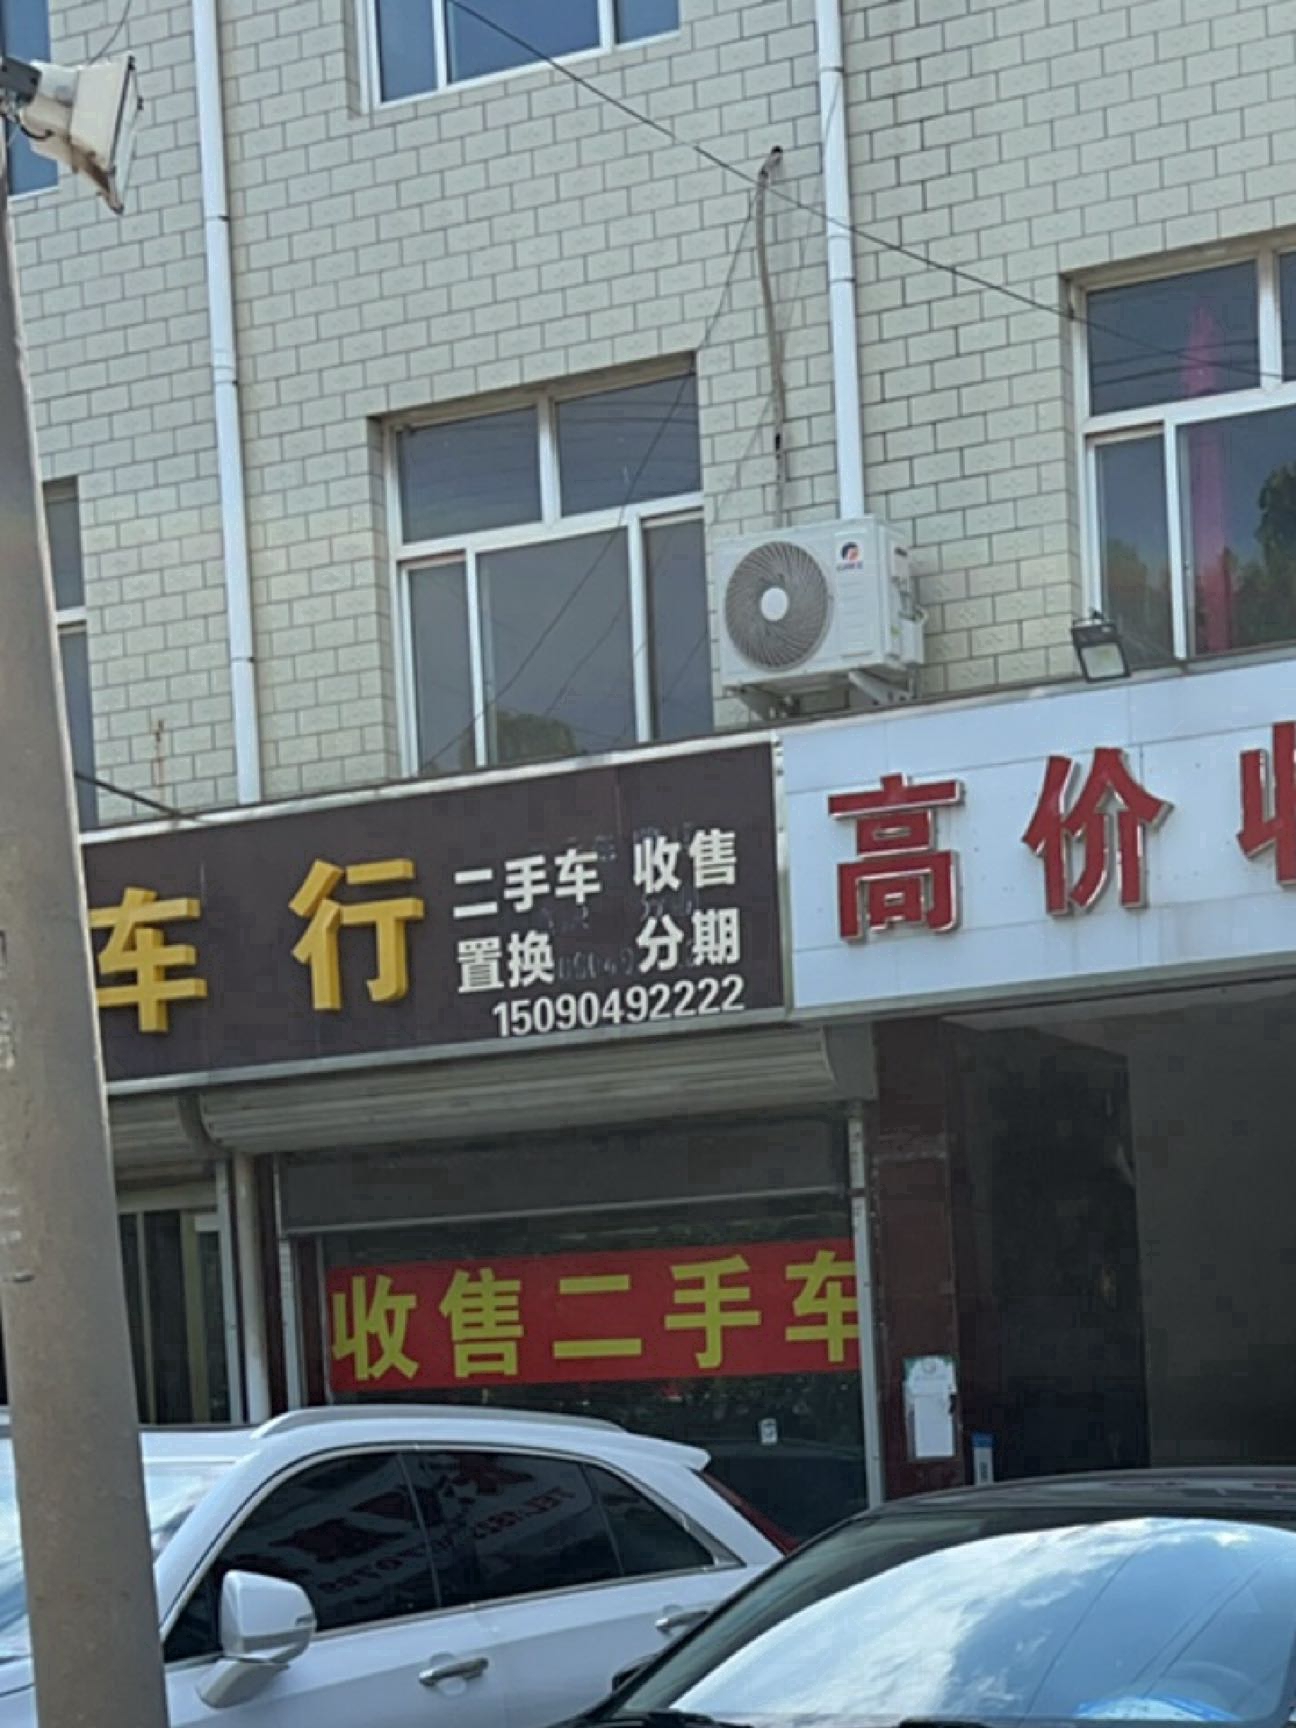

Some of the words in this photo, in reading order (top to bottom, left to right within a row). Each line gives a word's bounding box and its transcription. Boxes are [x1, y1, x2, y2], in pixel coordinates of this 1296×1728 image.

[453, 849, 601, 920] 二手车
[632, 828, 737, 893] 收售
[457, 929, 555, 993] 置换
[635, 907, 740, 973] 分期
[492, 974, 744, 1037] 15090492222
[332, 1250, 859, 1381] 收售二手车
